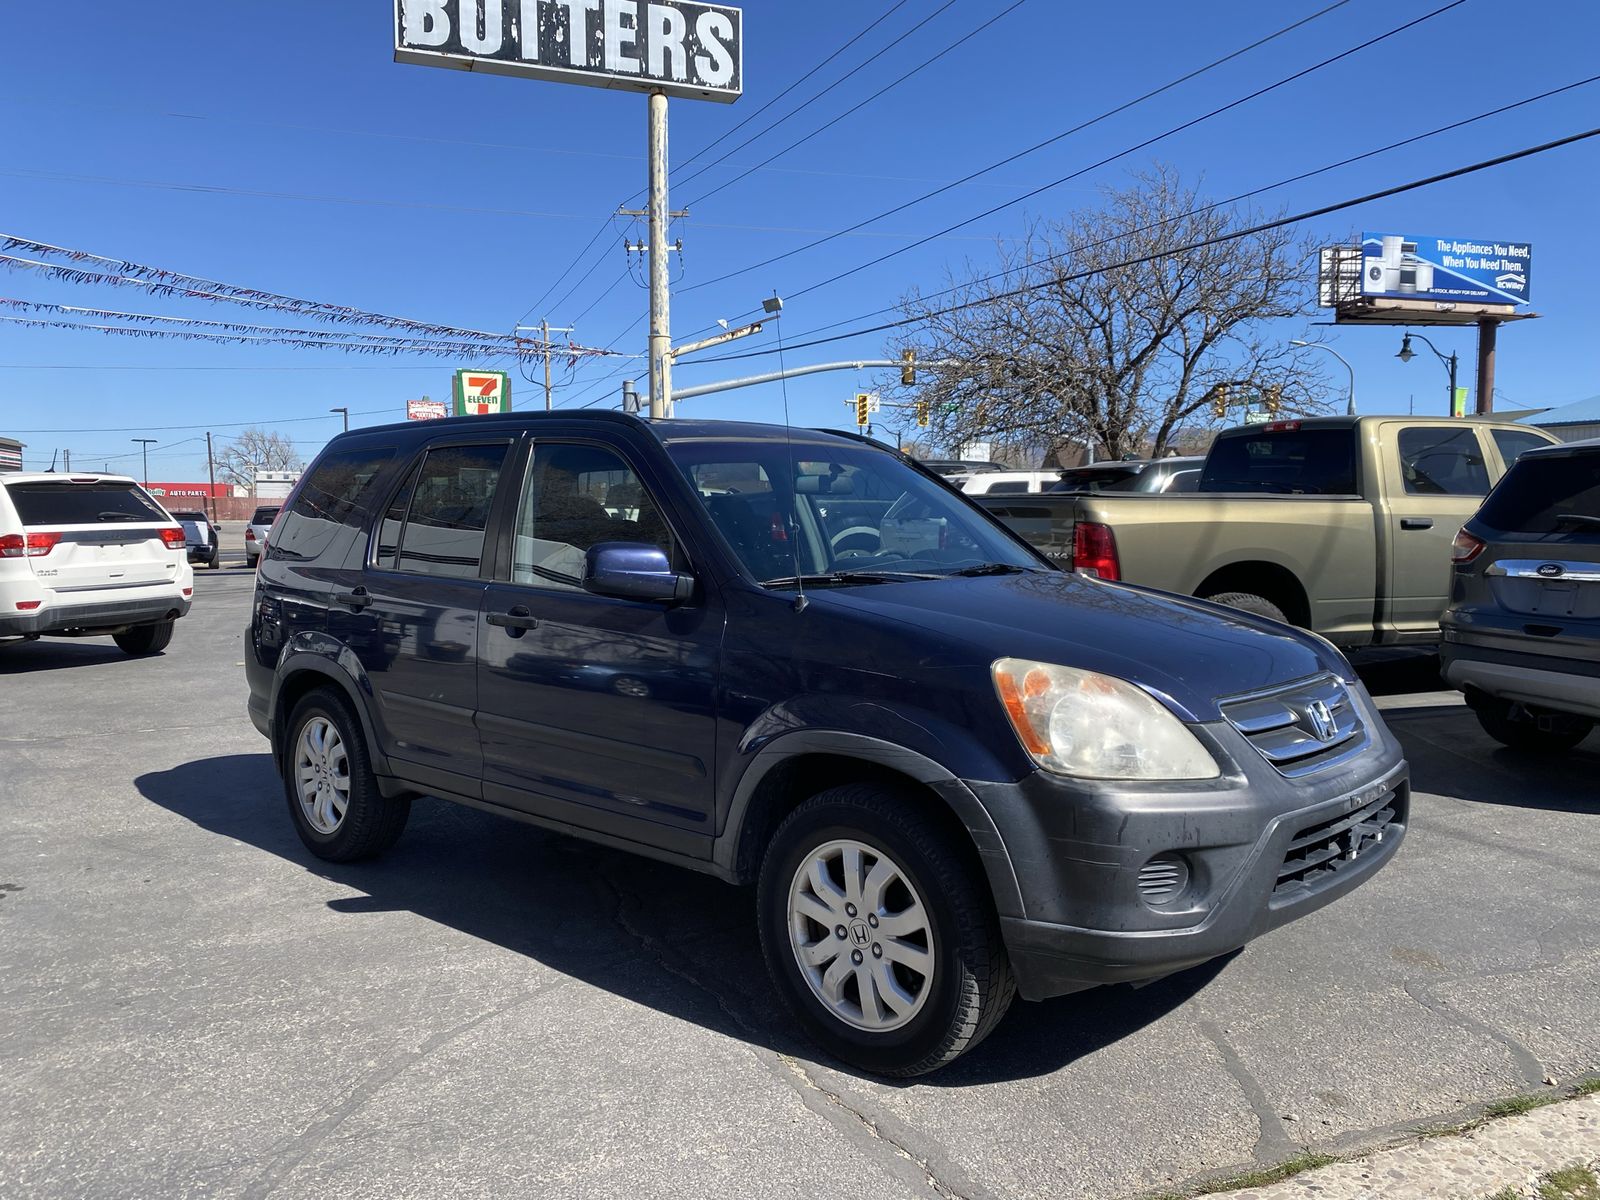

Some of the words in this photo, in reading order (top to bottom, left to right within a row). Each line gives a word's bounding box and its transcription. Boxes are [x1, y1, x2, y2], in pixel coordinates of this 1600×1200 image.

[402, 0, 736, 86] BUTTERS
[1437, 240, 1451, 252] The
[1452, 241, 1493, 255] Appliances
[1494, 244, 1508, 256] You
[1508, 245, 1530, 259] Need,
[1443, 256, 1464, 267] When
[1465, 257, 1479, 269] You
[1480, 259, 1500, 270] Need
[1501, 260, 1524, 272] Them.
[468, 377, 497, 413] 7
